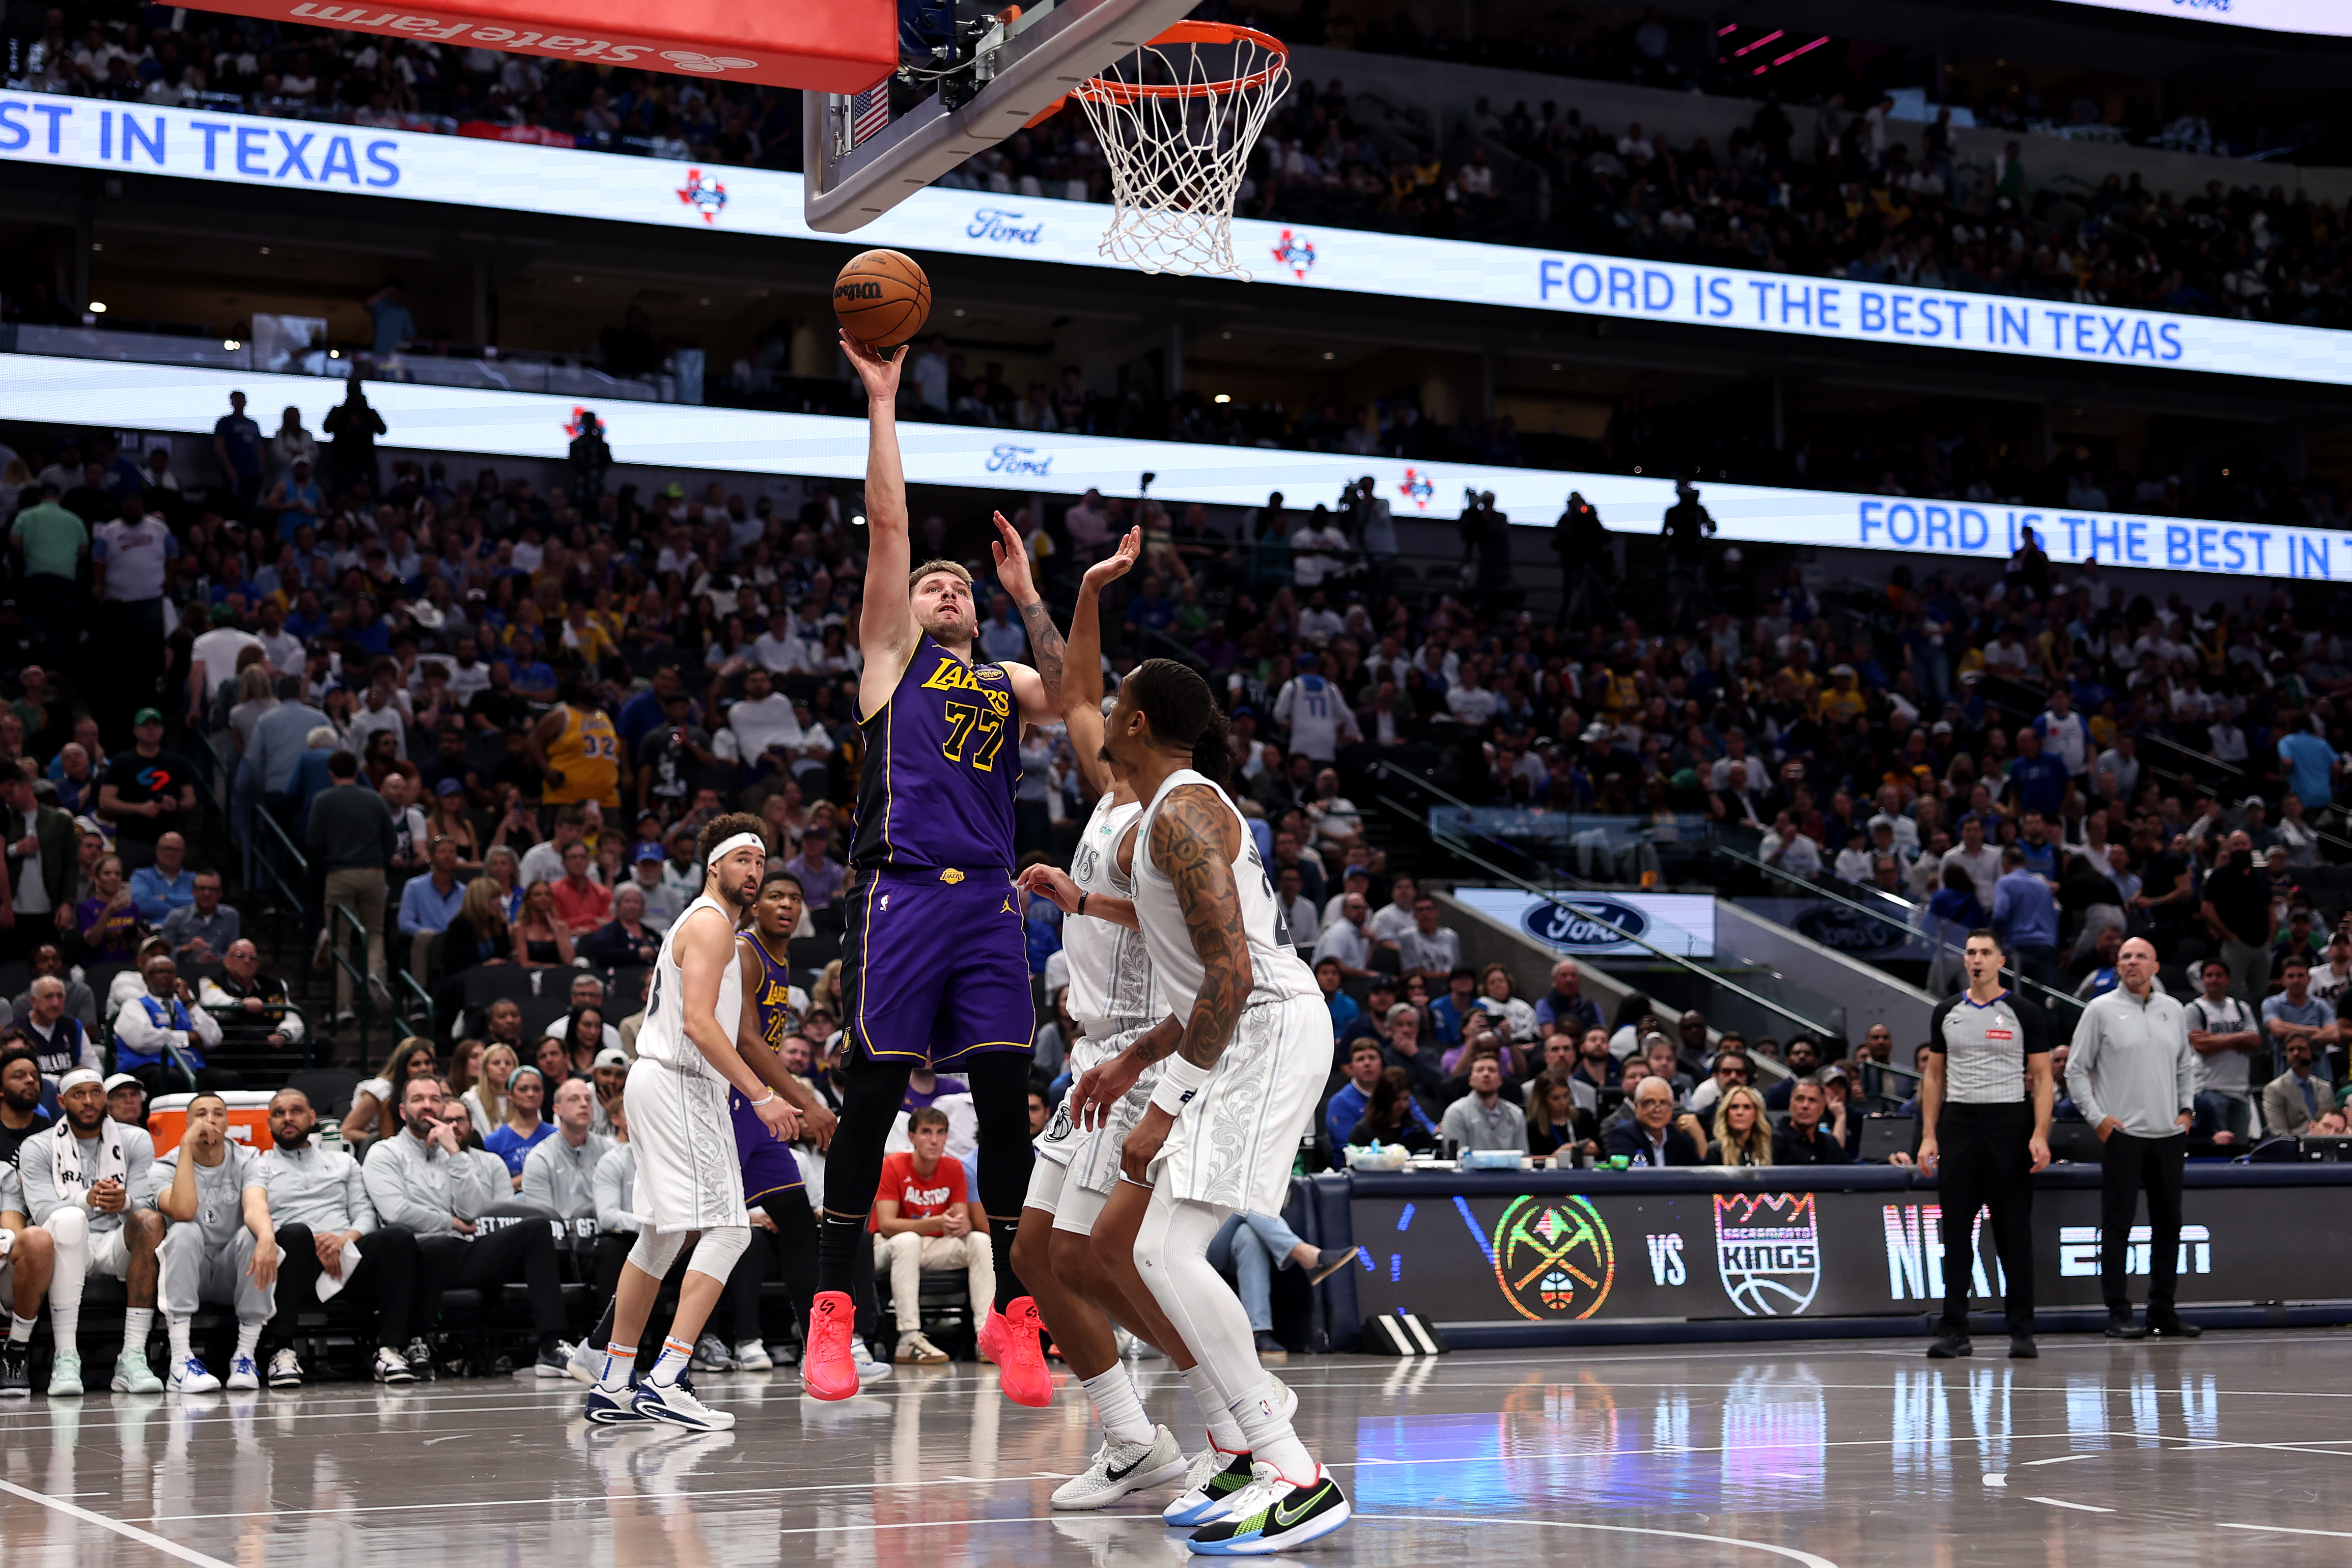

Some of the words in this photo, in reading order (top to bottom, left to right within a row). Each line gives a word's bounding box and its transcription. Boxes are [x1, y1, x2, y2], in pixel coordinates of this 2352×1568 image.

[100, 109, 166, 166] IN
[190, 120, 401, 188] TEXAS
[966, 206, 1045, 245] Ford
[1539, 259, 1675, 312] FORD
[1694, 274, 1734, 319] IS
[1748, 279, 1841, 329] THE
[1859, 290, 1969, 340] BEST
[1986, 302, 2030, 347] IN
[2043, 310, 2184, 362] TEXAS
[986, 443, 1054, 477] Ford
[1858, 500, 1991, 552] FORD
[2006, 511, 2047, 554] IS
[2058, 516, 2149, 568] THE
[2165, 524, 2273, 576] BEST
[2286, 534, 2333, 581] IN
[581, 734, 618, 762] 32
[942, 700, 1005, 772] 77
[1546, 902, 1627, 941] Ford
[1645, 1233, 1687, 1286] VS
[1723, 1245, 1815, 1270] KINGS
